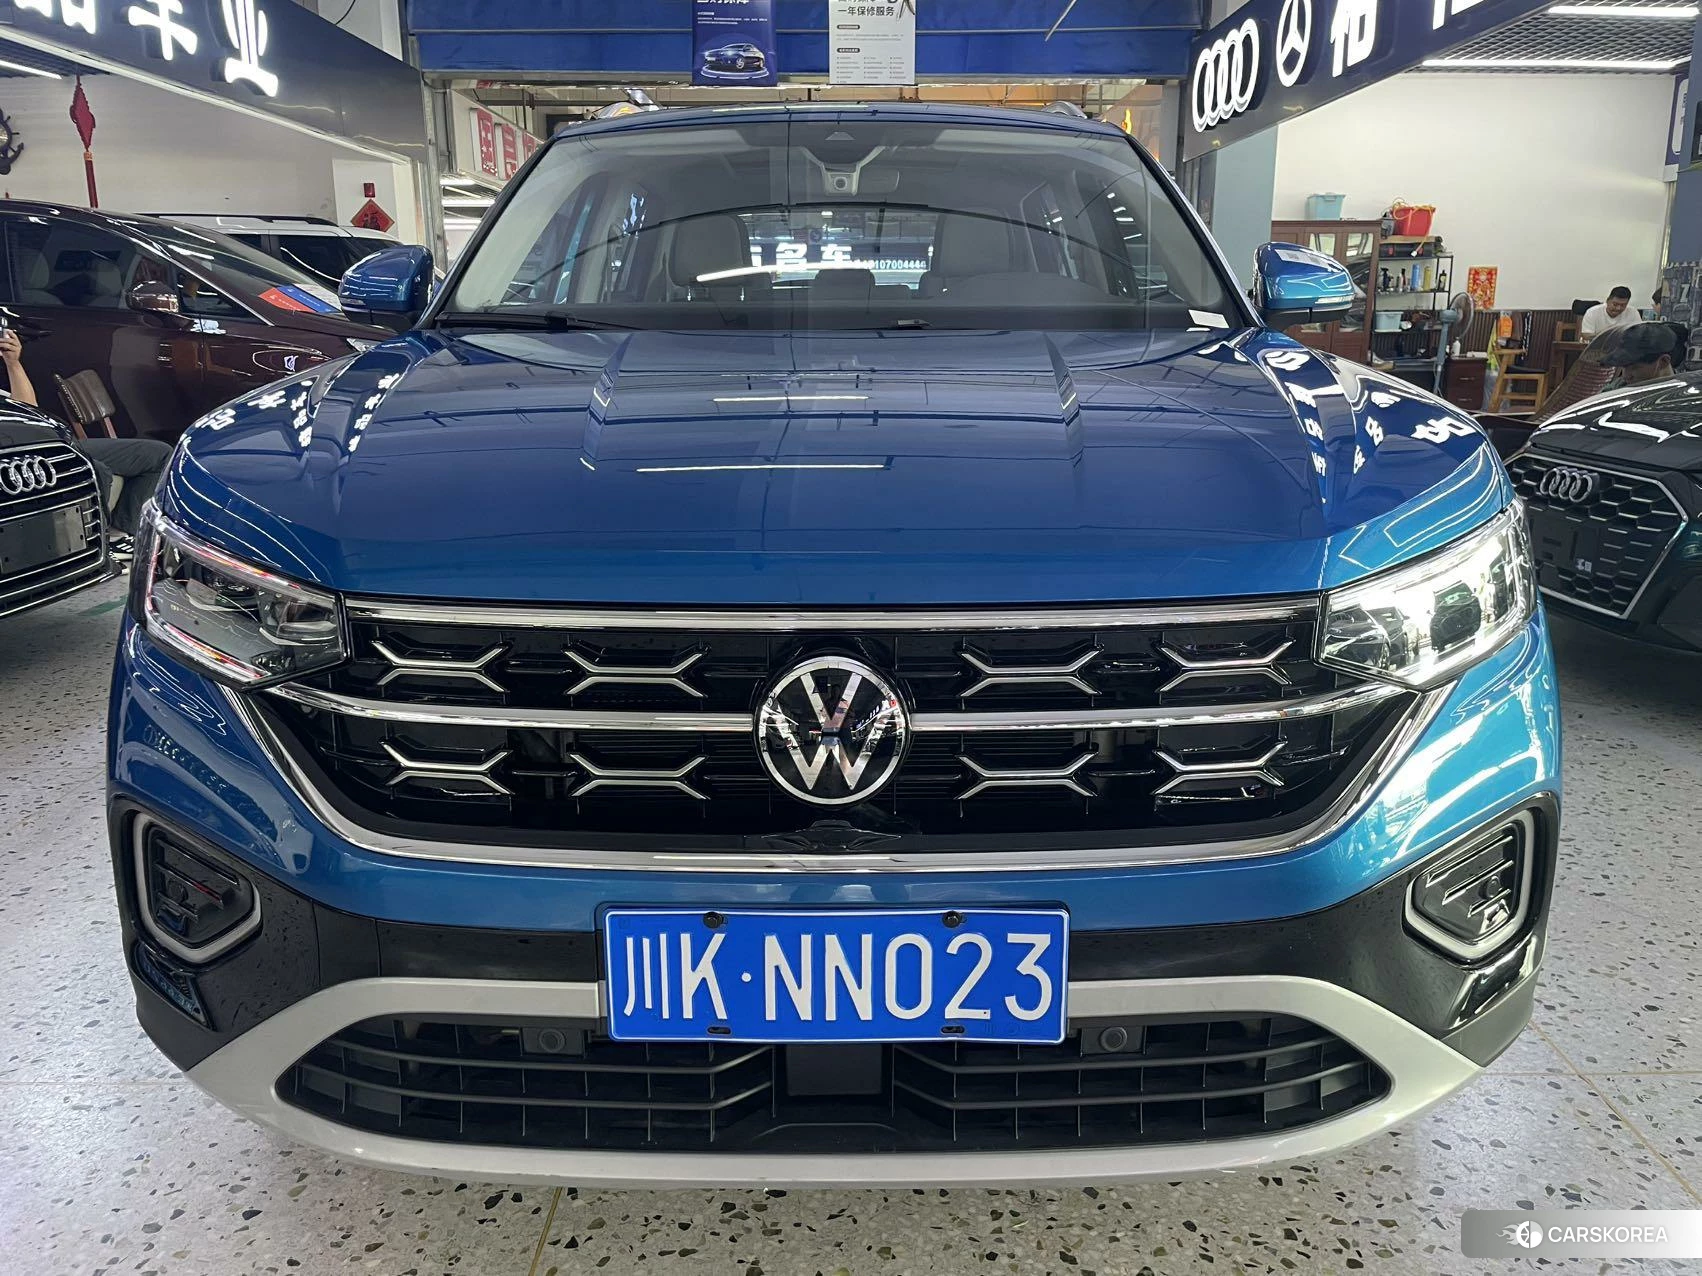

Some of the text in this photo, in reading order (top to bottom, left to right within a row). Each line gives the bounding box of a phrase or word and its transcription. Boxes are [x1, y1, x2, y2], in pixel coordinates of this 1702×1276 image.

[837, 6, 895, 16] 一年保修服务
